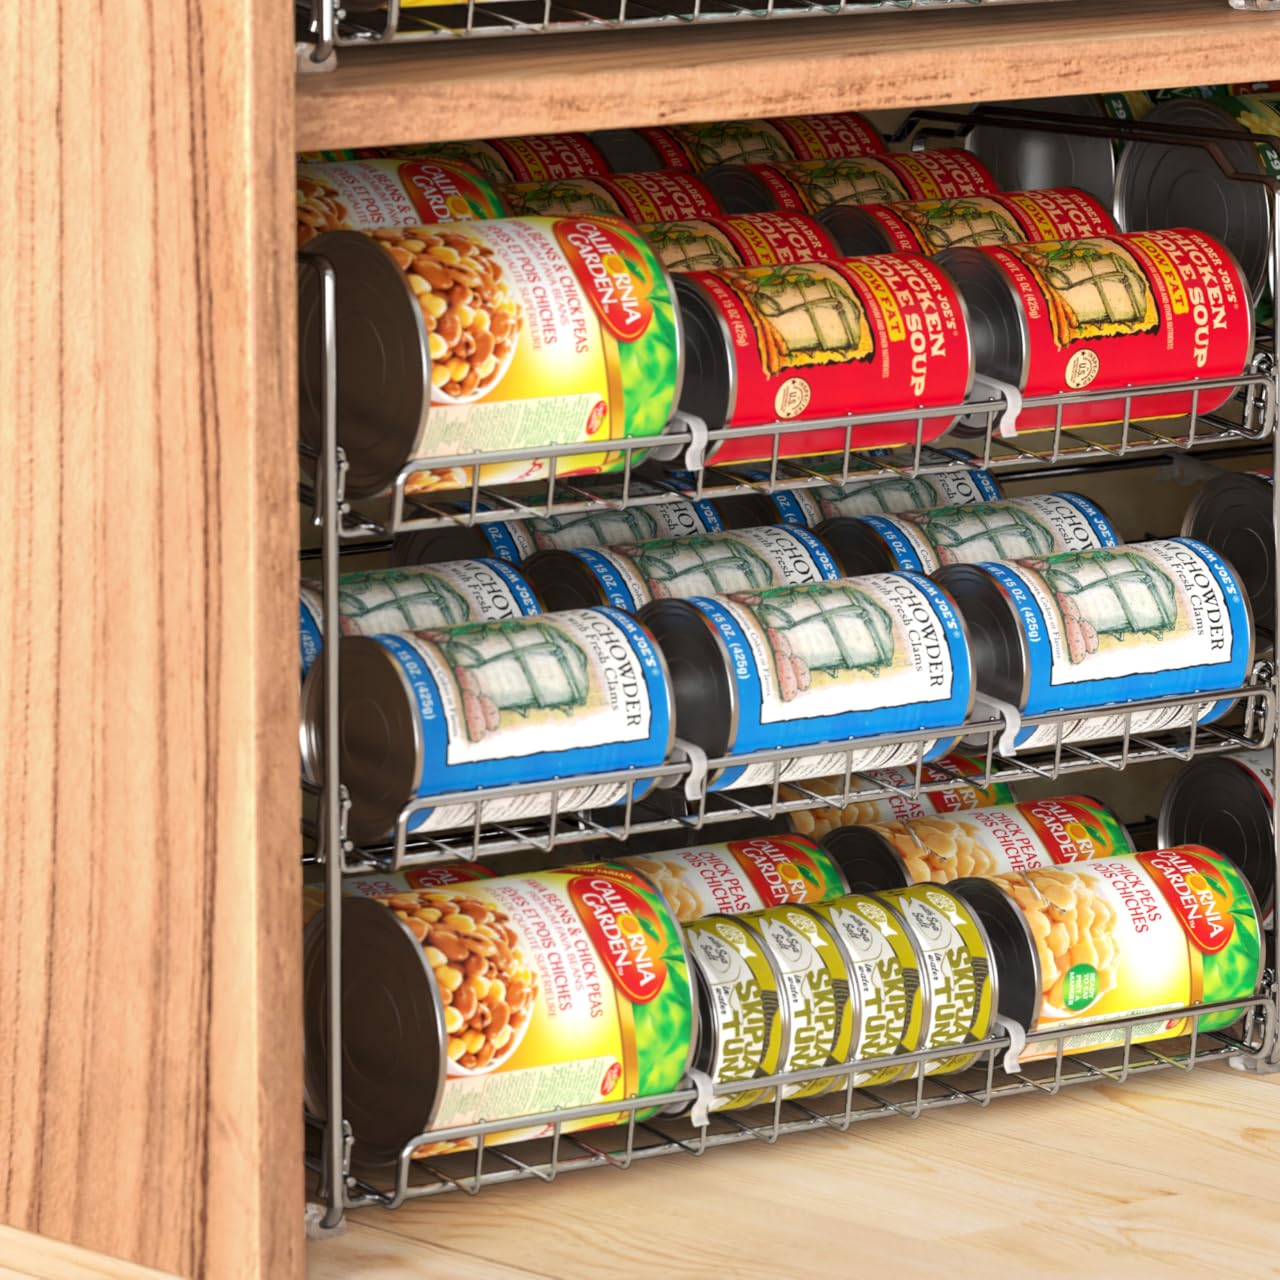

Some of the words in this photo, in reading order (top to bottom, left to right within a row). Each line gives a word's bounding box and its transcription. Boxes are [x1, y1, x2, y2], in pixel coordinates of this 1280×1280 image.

[518, 256, 540, 283] POIS
[532, 286, 557, 344] CHICHES
[567, 233, 619, 304] GARDEN
[908, 259, 941, 291] TRADER
[937, 293, 956, 330] JOE'S
[1158, 230, 1228, 329] CHICKEN
[1166, 270, 1185, 307] FAT
[1190, 234, 1222, 266] TRADER
[1217, 268, 1237, 303] JOE'S
[560, 275, 583, 315] CHICK
[573, 318, 588, 354] PEAS
[875, 254, 946, 357] CHICKEN
[883, 295, 901, 333] FAT
[1188, 287, 1209, 368] SOUP
[905, 313, 927, 396] SOUP
[1170, 562, 1196, 594] Fresh
[1190, 593, 1205, 636] Clams
[1173, 549, 1226, 652] CHOWDER
[1215, 563, 1238, 596] JOE'S
[893, 583, 946, 688] CHOWDER
[908, 627, 923, 673] Clams
[935, 601, 958, 632] JOE'S
[1020, 606, 1042, 643] (425g)
[595, 621, 644, 728] CHOWDER
[603, 668, 620, 713] Clams
[699, 850, 730, 883] CHICK
[723, 875, 751, 912] PEAS
[1088, 862, 1114, 890] POIS
[1109, 881, 1149, 934] CHICHES
[1109, 862, 1145, 896] CHICK
[1134, 888, 1163, 922] PEAS
[1148, 858, 1203, 921] GARDEN
[534, 920, 556, 948] POIS
[548, 951, 572, 1011] CHICHES
[582, 892, 632, 967] GARDEN
[574, 939, 597, 980] CHICK
[588, 982, 603, 1018] PEAS
[735, 979, 765, 1078] SKIPJA
